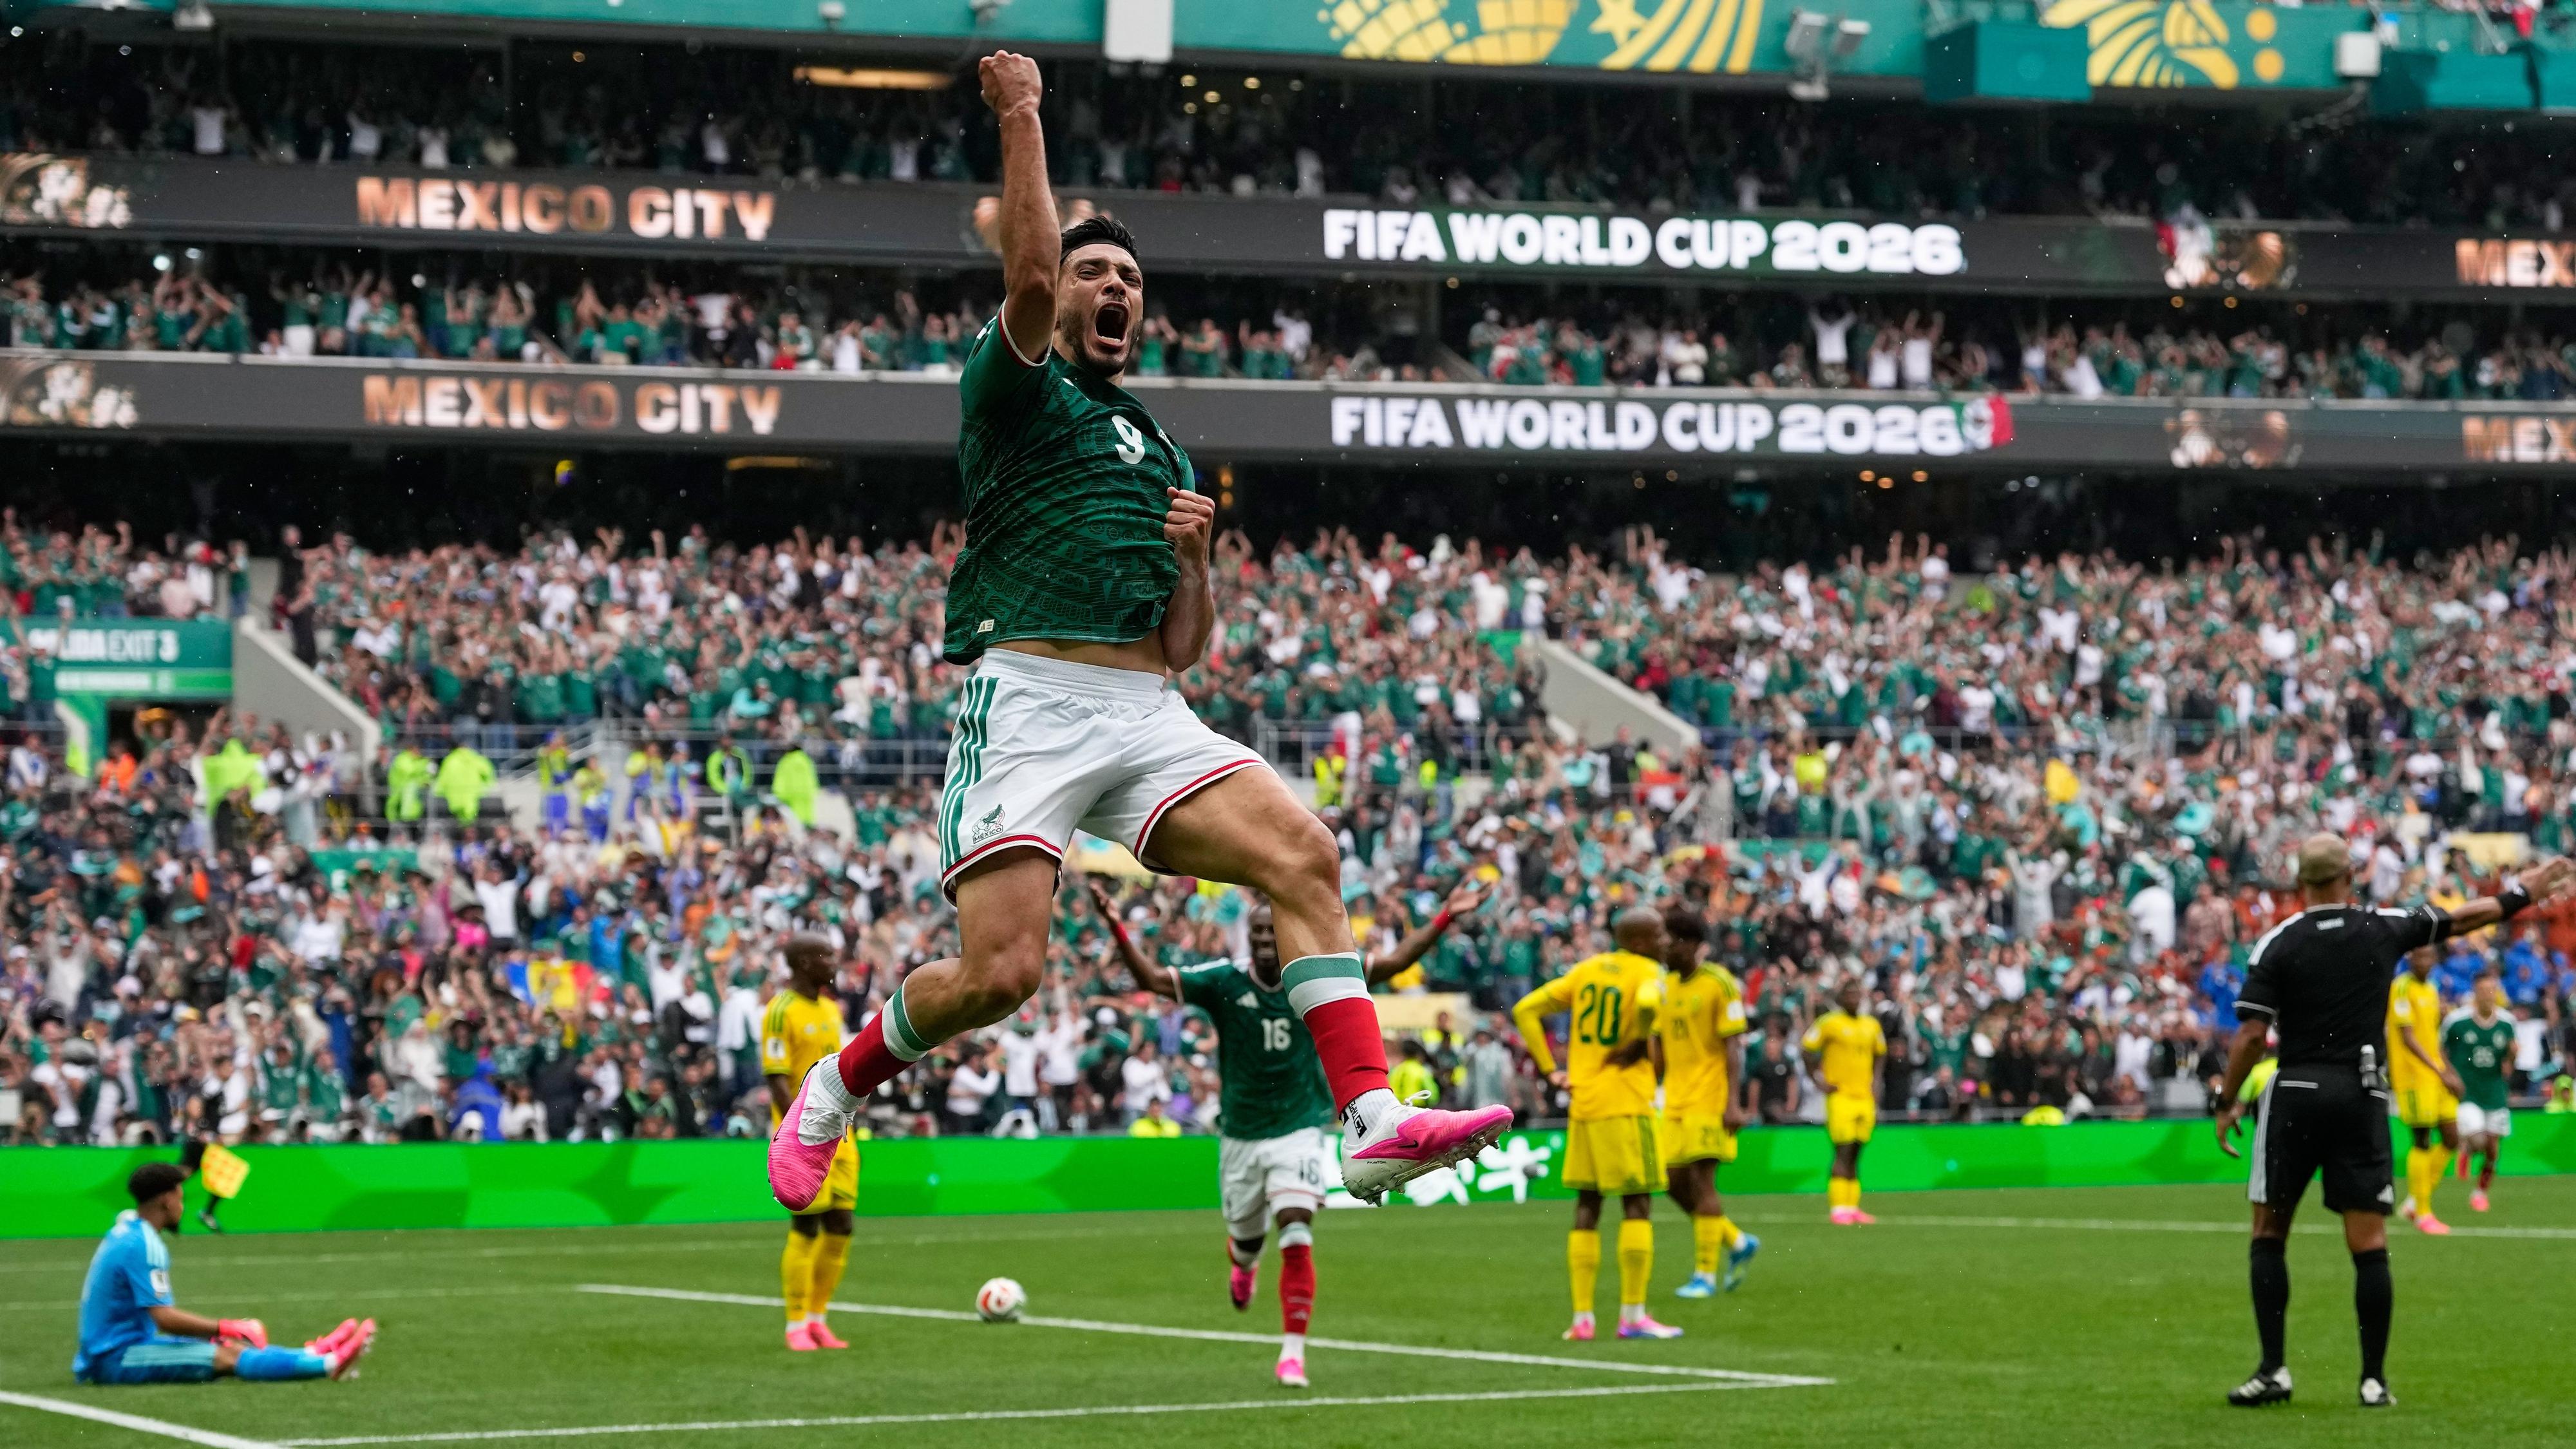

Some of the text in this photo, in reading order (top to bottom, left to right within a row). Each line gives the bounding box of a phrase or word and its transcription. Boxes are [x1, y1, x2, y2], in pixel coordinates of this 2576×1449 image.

[356, 177, 775, 242] MEXICO CITY
[1323, 209, 1964, 276] FIFA WORLD CUP 2026
[2455, 238, 2576, 287] MEX
[363, 375, 781, 435] MEXICO CITY
[1331, 396, 1965, 457] FIFA WORLD CUP 2026
[1112, 415, 1145, 464] 9
[108, 629, 156, 663] EXIT
[1261, 1018, 1291, 1052] 16
[1579, 983, 1622, 1045] 20
[1348, 1099, 1359, 1121] TAPE
